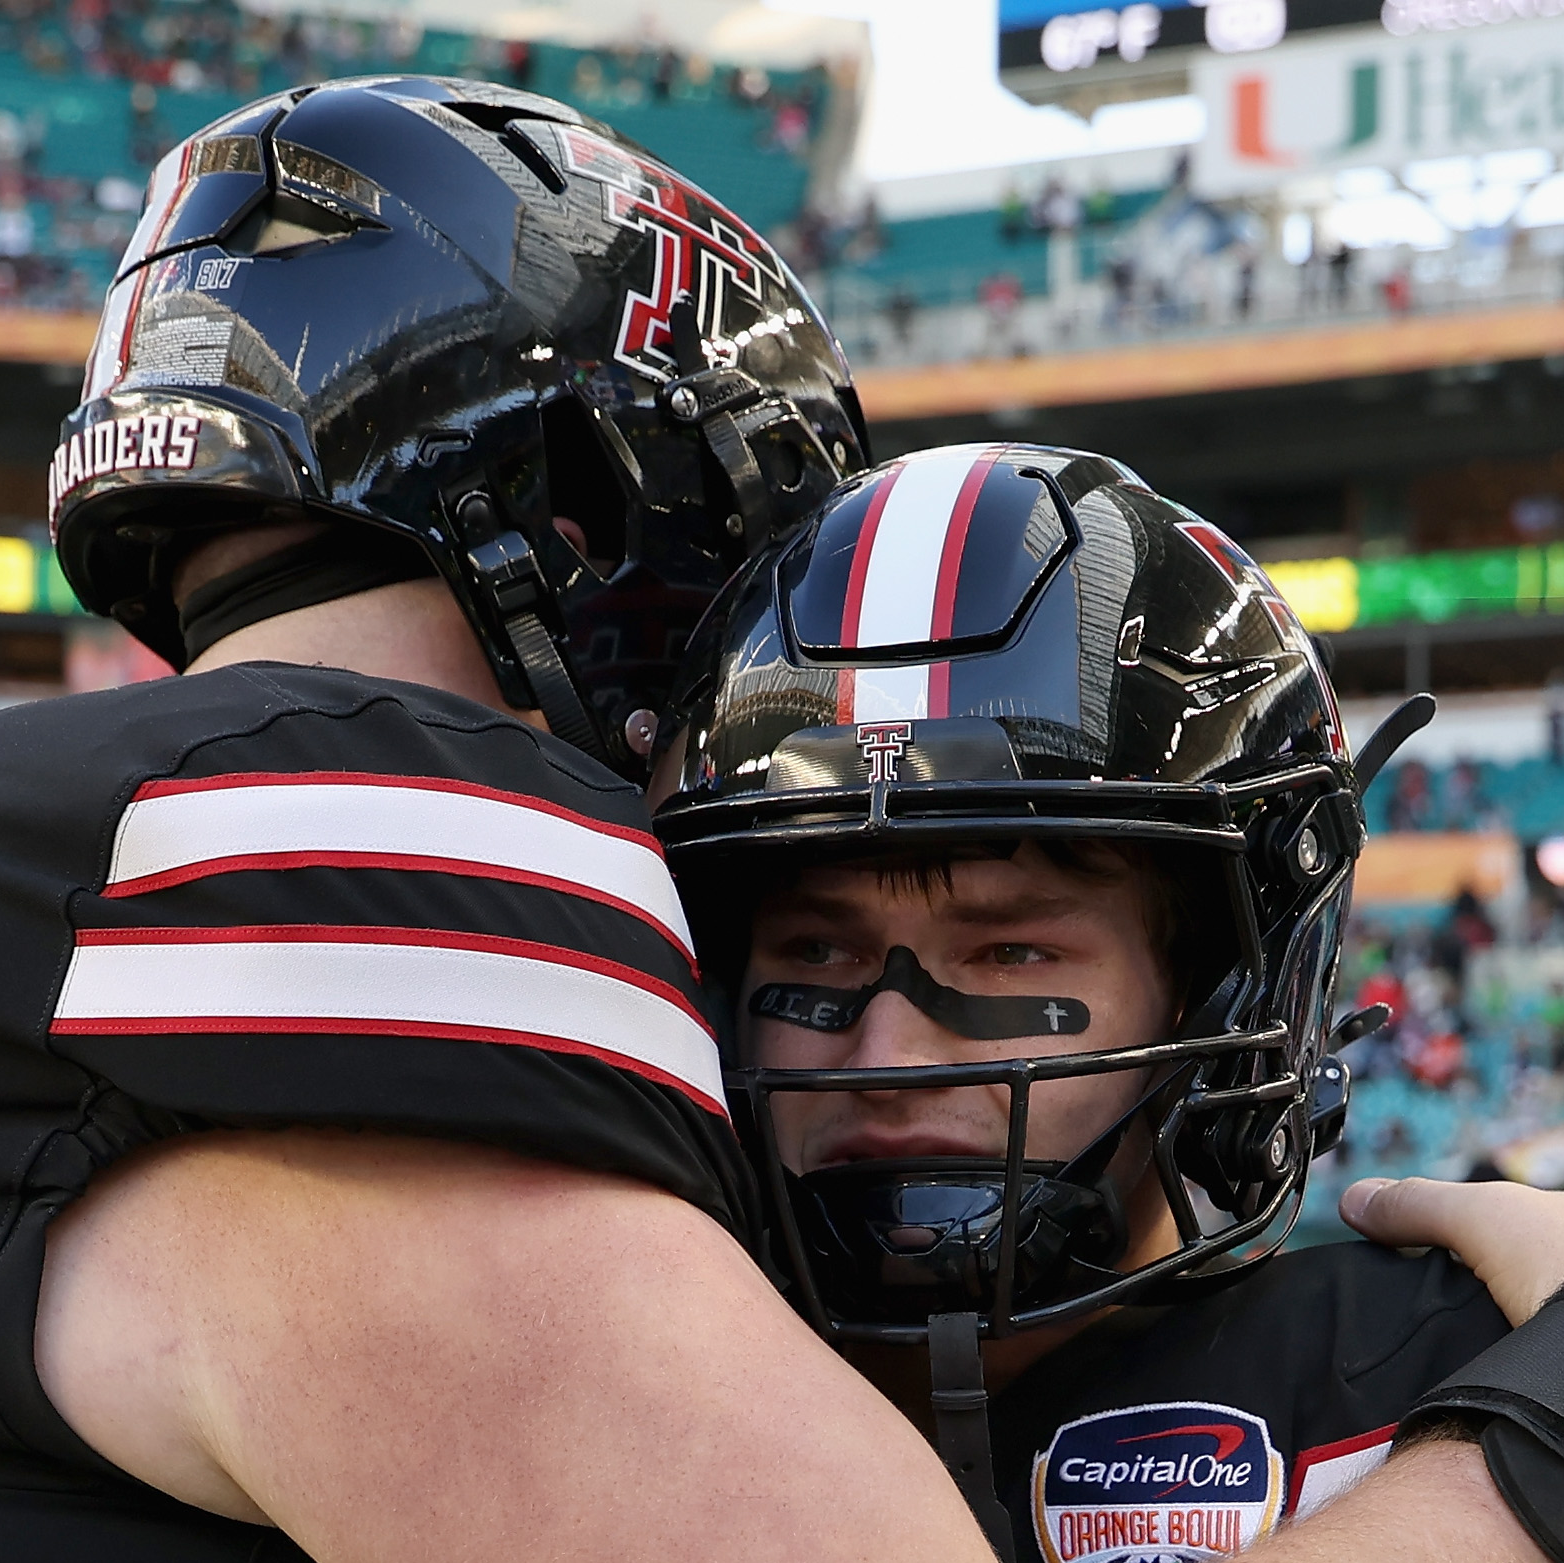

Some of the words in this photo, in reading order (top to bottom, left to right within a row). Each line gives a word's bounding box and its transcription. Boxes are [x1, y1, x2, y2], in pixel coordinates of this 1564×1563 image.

[158, 316, 207, 330] WARNING
[54, 416, 201, 501] RAIDERS
[1058, 1509, 1160, 1561] ORANGE
